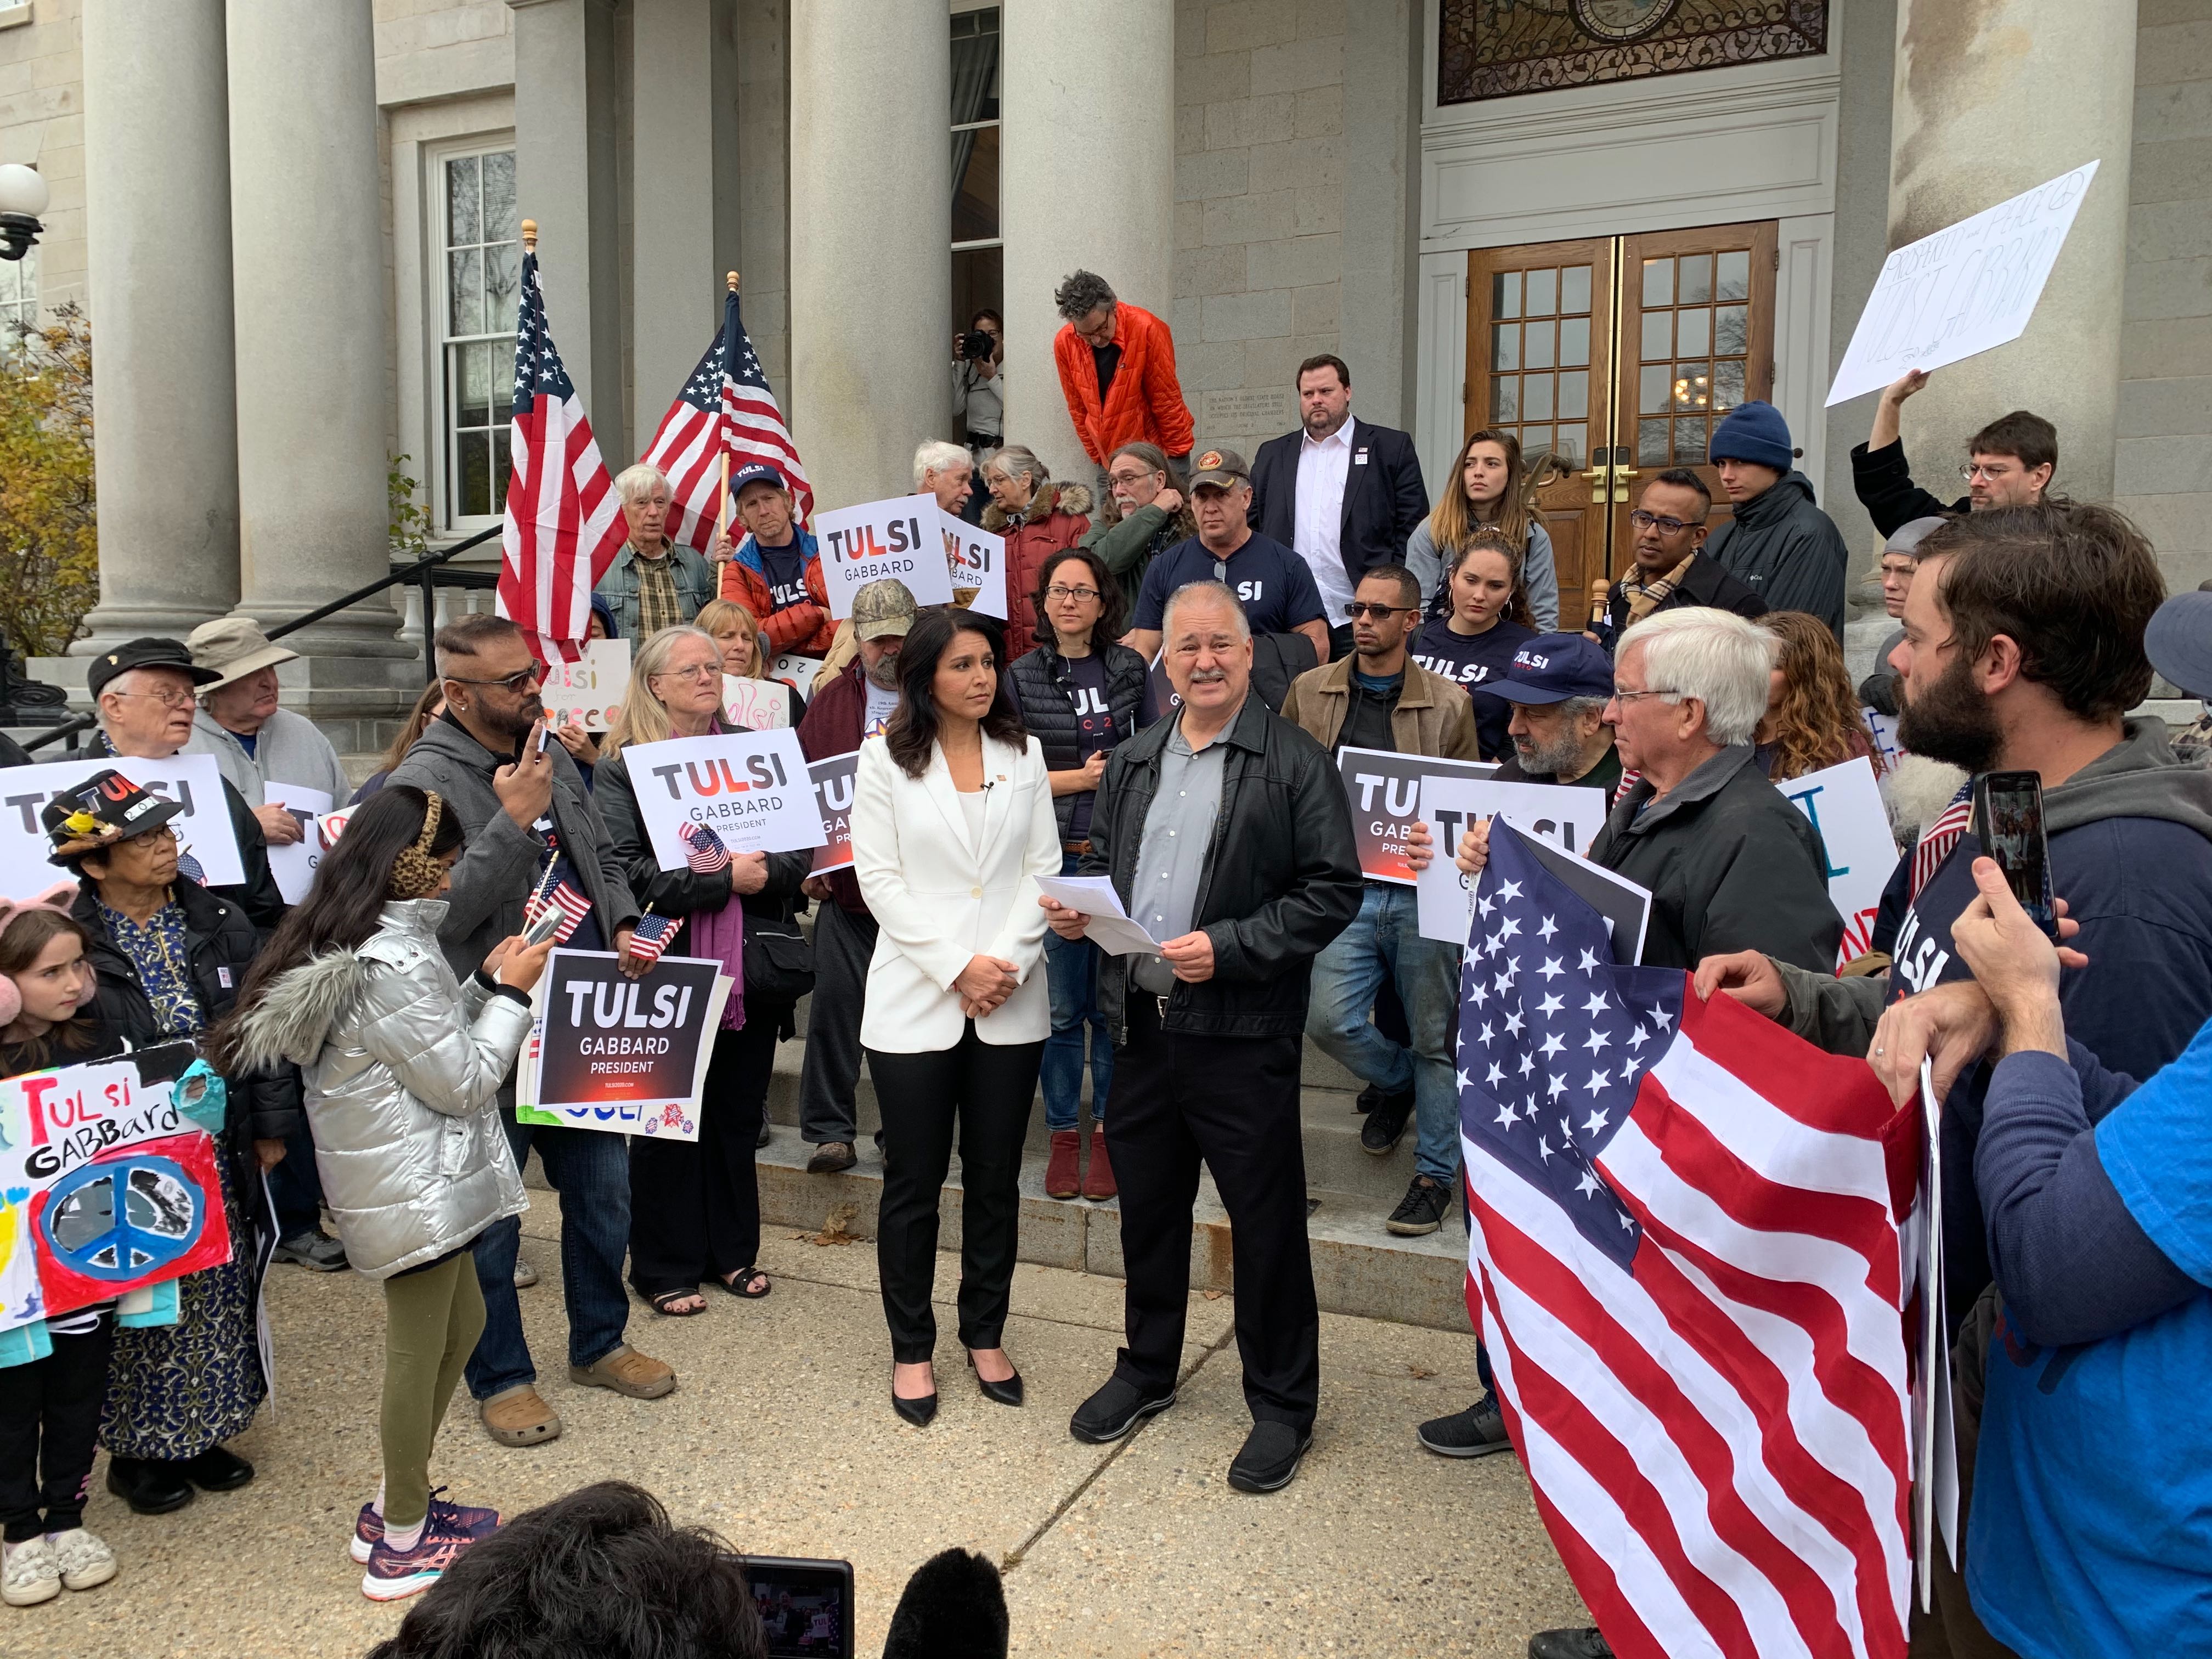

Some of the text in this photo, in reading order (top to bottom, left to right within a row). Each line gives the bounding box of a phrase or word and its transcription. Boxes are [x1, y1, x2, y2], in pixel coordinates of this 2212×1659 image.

[737, 465, 765, 478] TULSI
[827, 517, 921, 563] TULSI
[845, 559, 914, 581] GABBARD
[950, 568, 983, 586] BARD
[1412, 654, 1488, 682] TULSI
[1514, 650, 1549, 669] TULSI
[651, 753, 788, 800] TULSI
[690, 795, 783, 822] GABBARD
[716, 819, 766, 833] PRESIDENT
[1370, 821, 1411, 840] GAB
[1382, 843, 1410, 856] PRE
[565, 980, 693, 1029] TULSI
[579, 1036, 670, 1056] GABBARD
[590, 1060, 654, 1075] PRESIDENT
